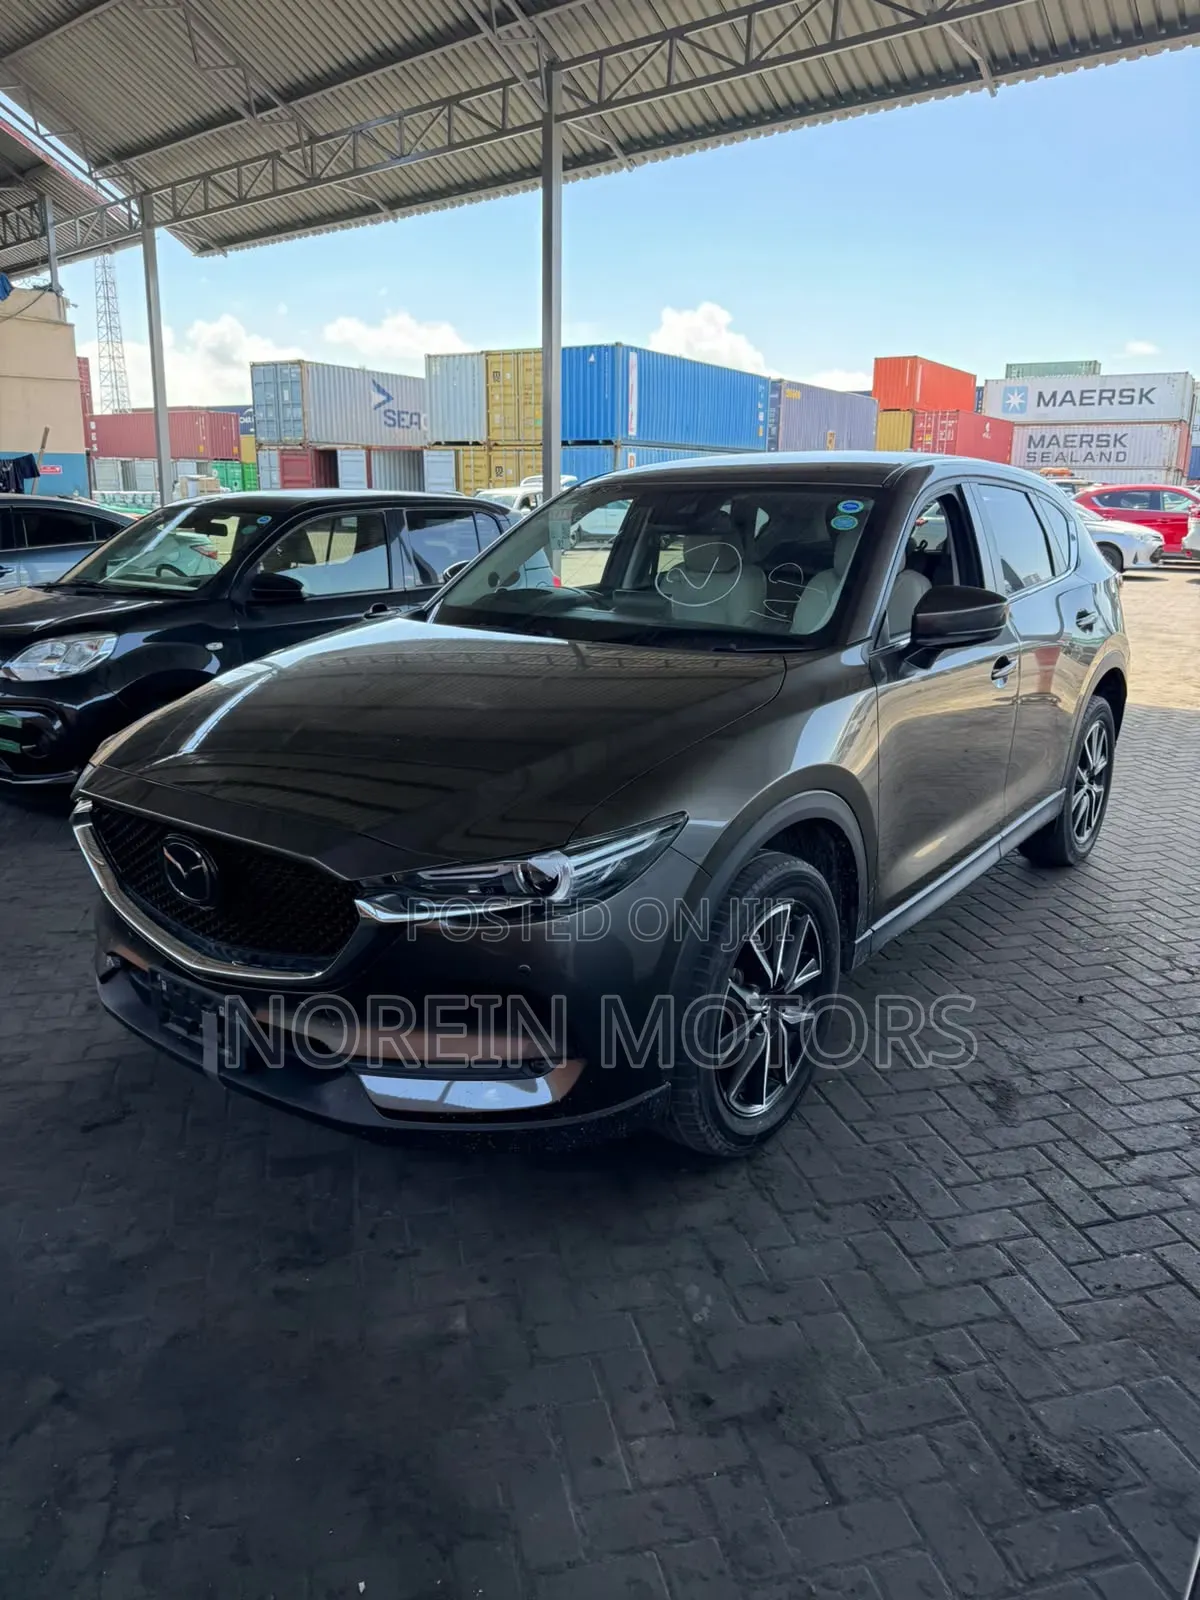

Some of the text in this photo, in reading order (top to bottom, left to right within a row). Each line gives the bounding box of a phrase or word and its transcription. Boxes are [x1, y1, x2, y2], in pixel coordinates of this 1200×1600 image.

[1036, 388, 1156, 408] MAERSK
[1027, 433, 1129, 449] MAERSK
[1026, 451, 1127, 463] SEALAND
